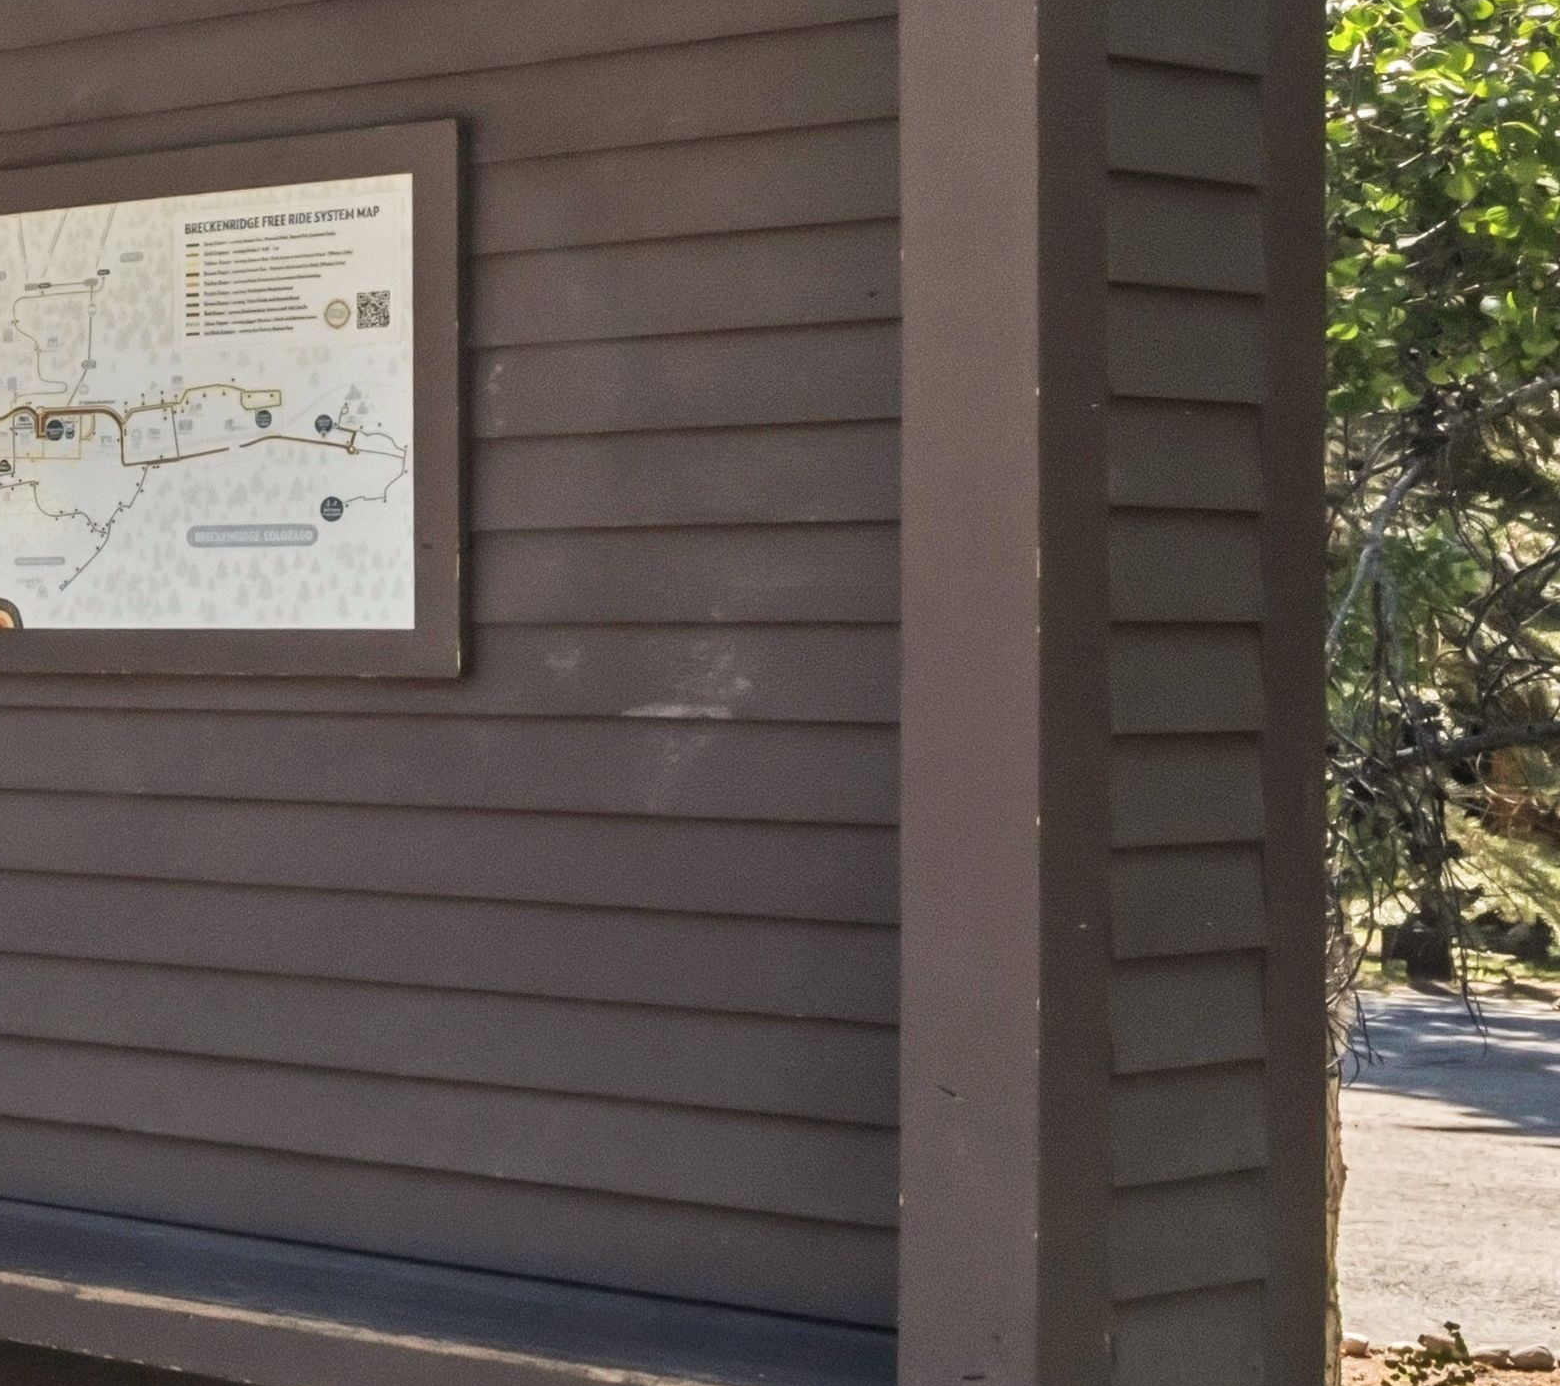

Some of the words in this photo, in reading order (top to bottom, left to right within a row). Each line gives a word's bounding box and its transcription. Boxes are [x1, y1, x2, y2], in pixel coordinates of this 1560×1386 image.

[184, 219, 260, 235] BRECKENRIDGE
[262, 216, 286, 228] FREE
[288, 213, 313, 225] RIDE
[313, 209, 355, 223] SYSTEM
[356, 205, 380, 218] MAP
